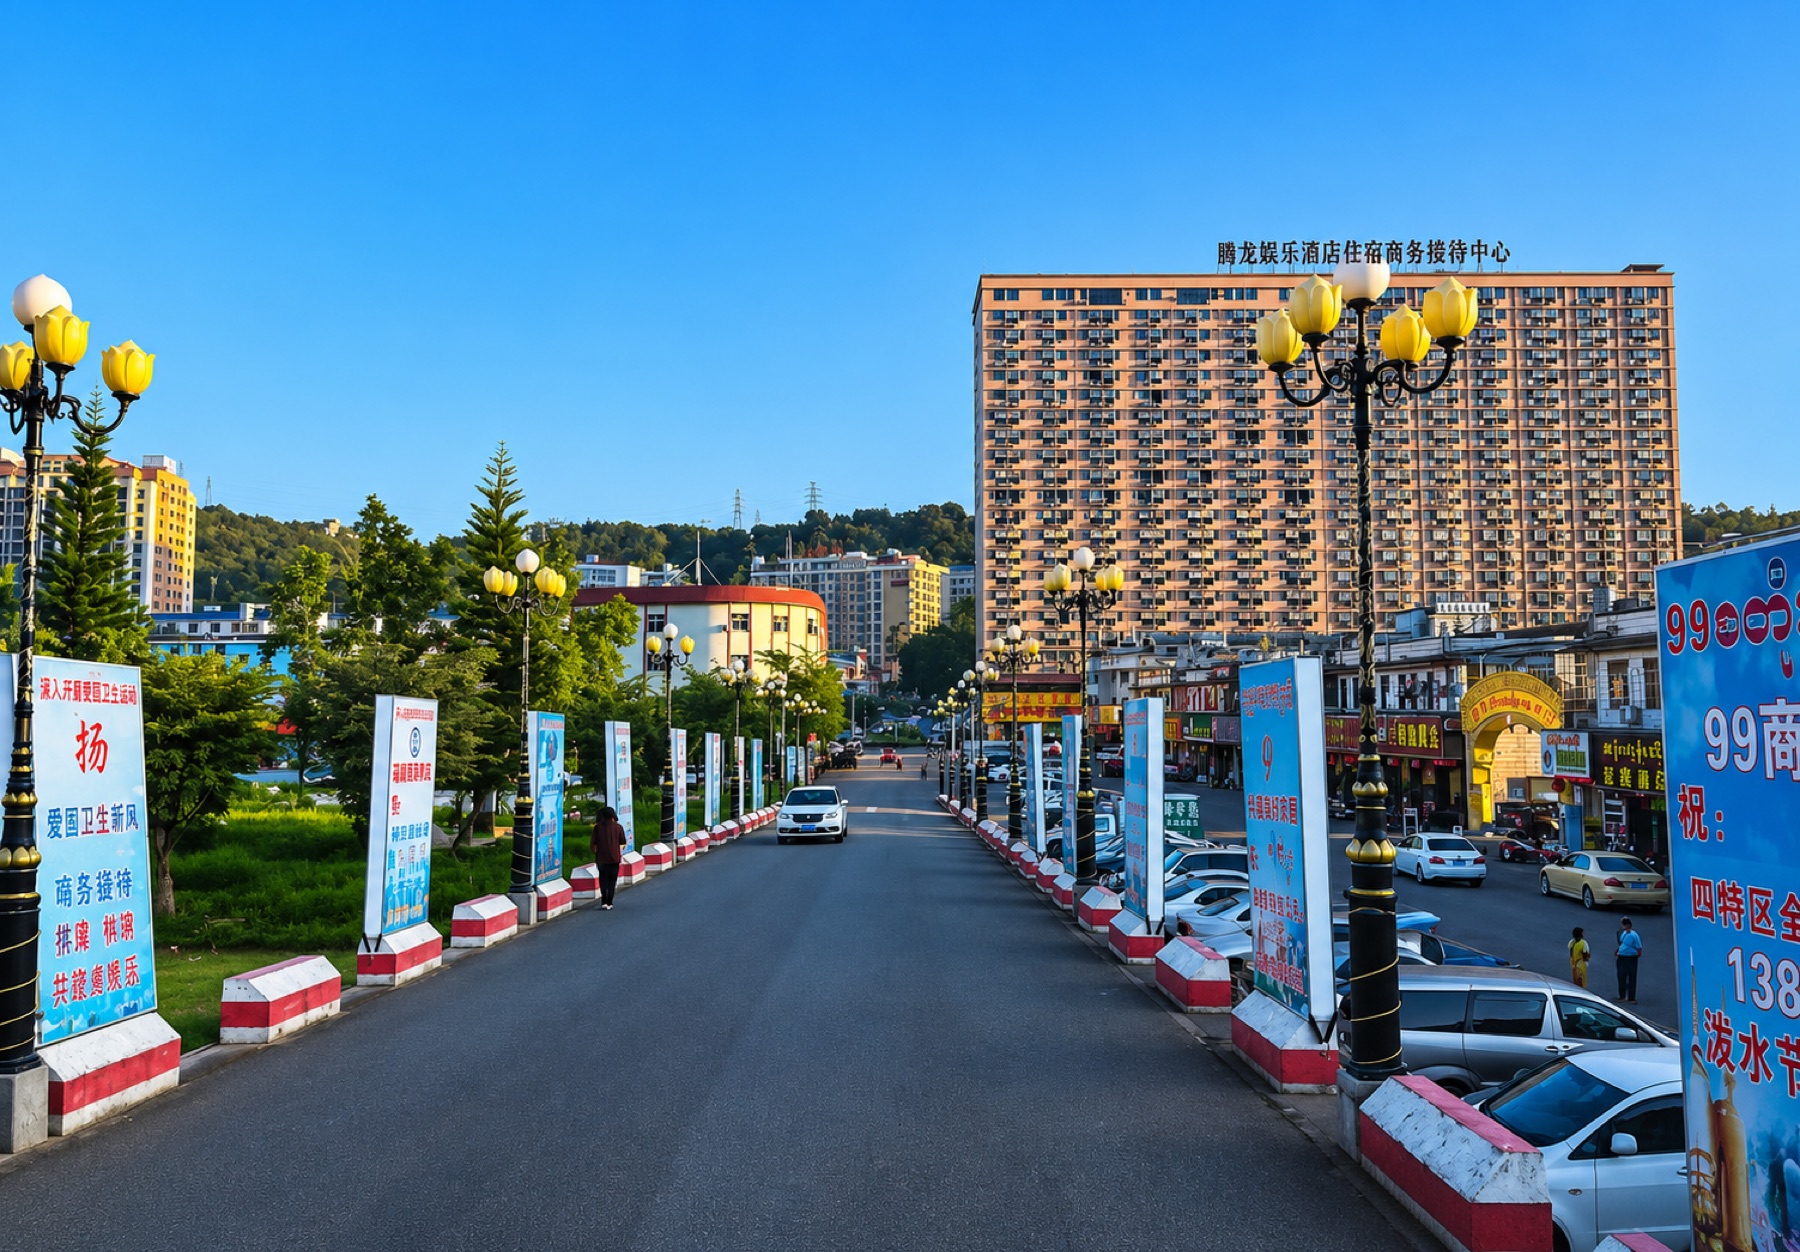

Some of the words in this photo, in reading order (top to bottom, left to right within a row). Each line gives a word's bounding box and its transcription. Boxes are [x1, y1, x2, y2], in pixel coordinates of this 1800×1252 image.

[75, 718, 110, 774] 扬
[46, 803, 139, 839] 爱国卫生新风
